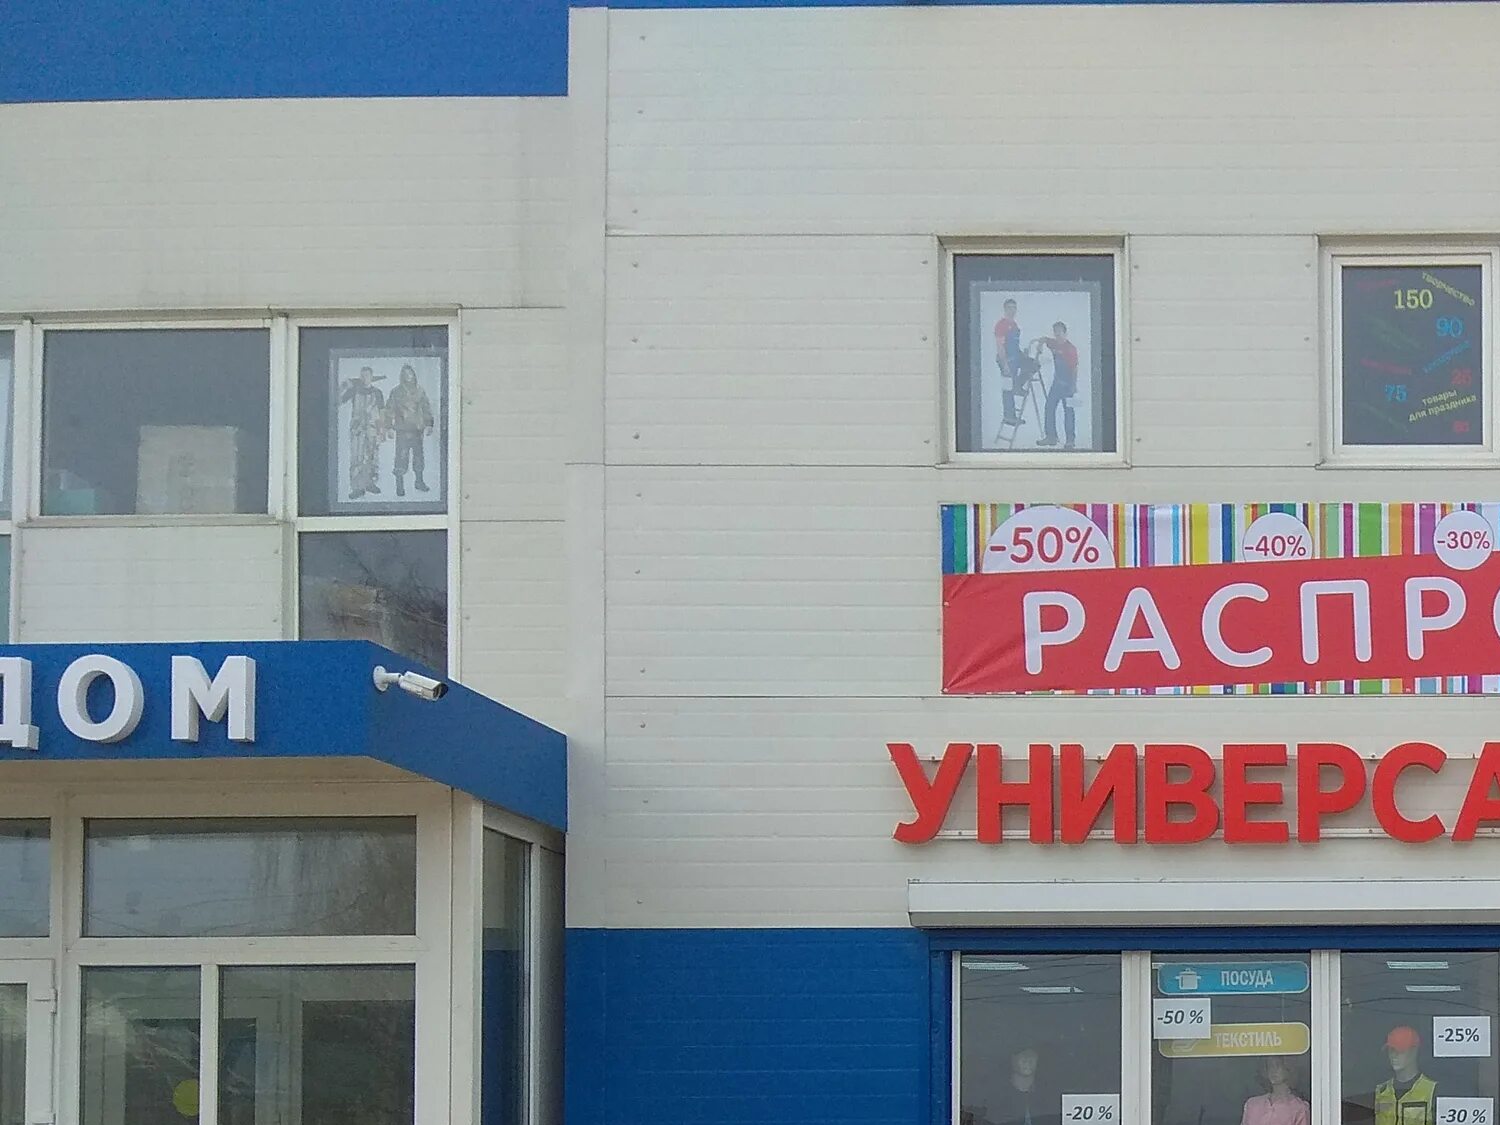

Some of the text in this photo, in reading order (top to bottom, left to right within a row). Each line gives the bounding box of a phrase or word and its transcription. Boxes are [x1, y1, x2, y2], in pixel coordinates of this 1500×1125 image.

[1393, 288, 1434, 310] 150
[1435, 315, 1464, 338] 90
[1384, 383, 1408, 403] 75
[988, 525, 1101, 566] -50%
[1243, 533, 1308, 559] -40%
[1436, 529, 1491, 552] -30%
[1220, 969, 1275, 988] ПОСУДА
[1157, 1009, 1186, 1025] -50
[1214, 1030, 1283, 1048] ТЕКСТИЛЬ
[1437, 1027, 1480, 1043] -25%
[1066, 1106, 1094, 1121] -20
[1439, 1108, 1468, 1124] -30
